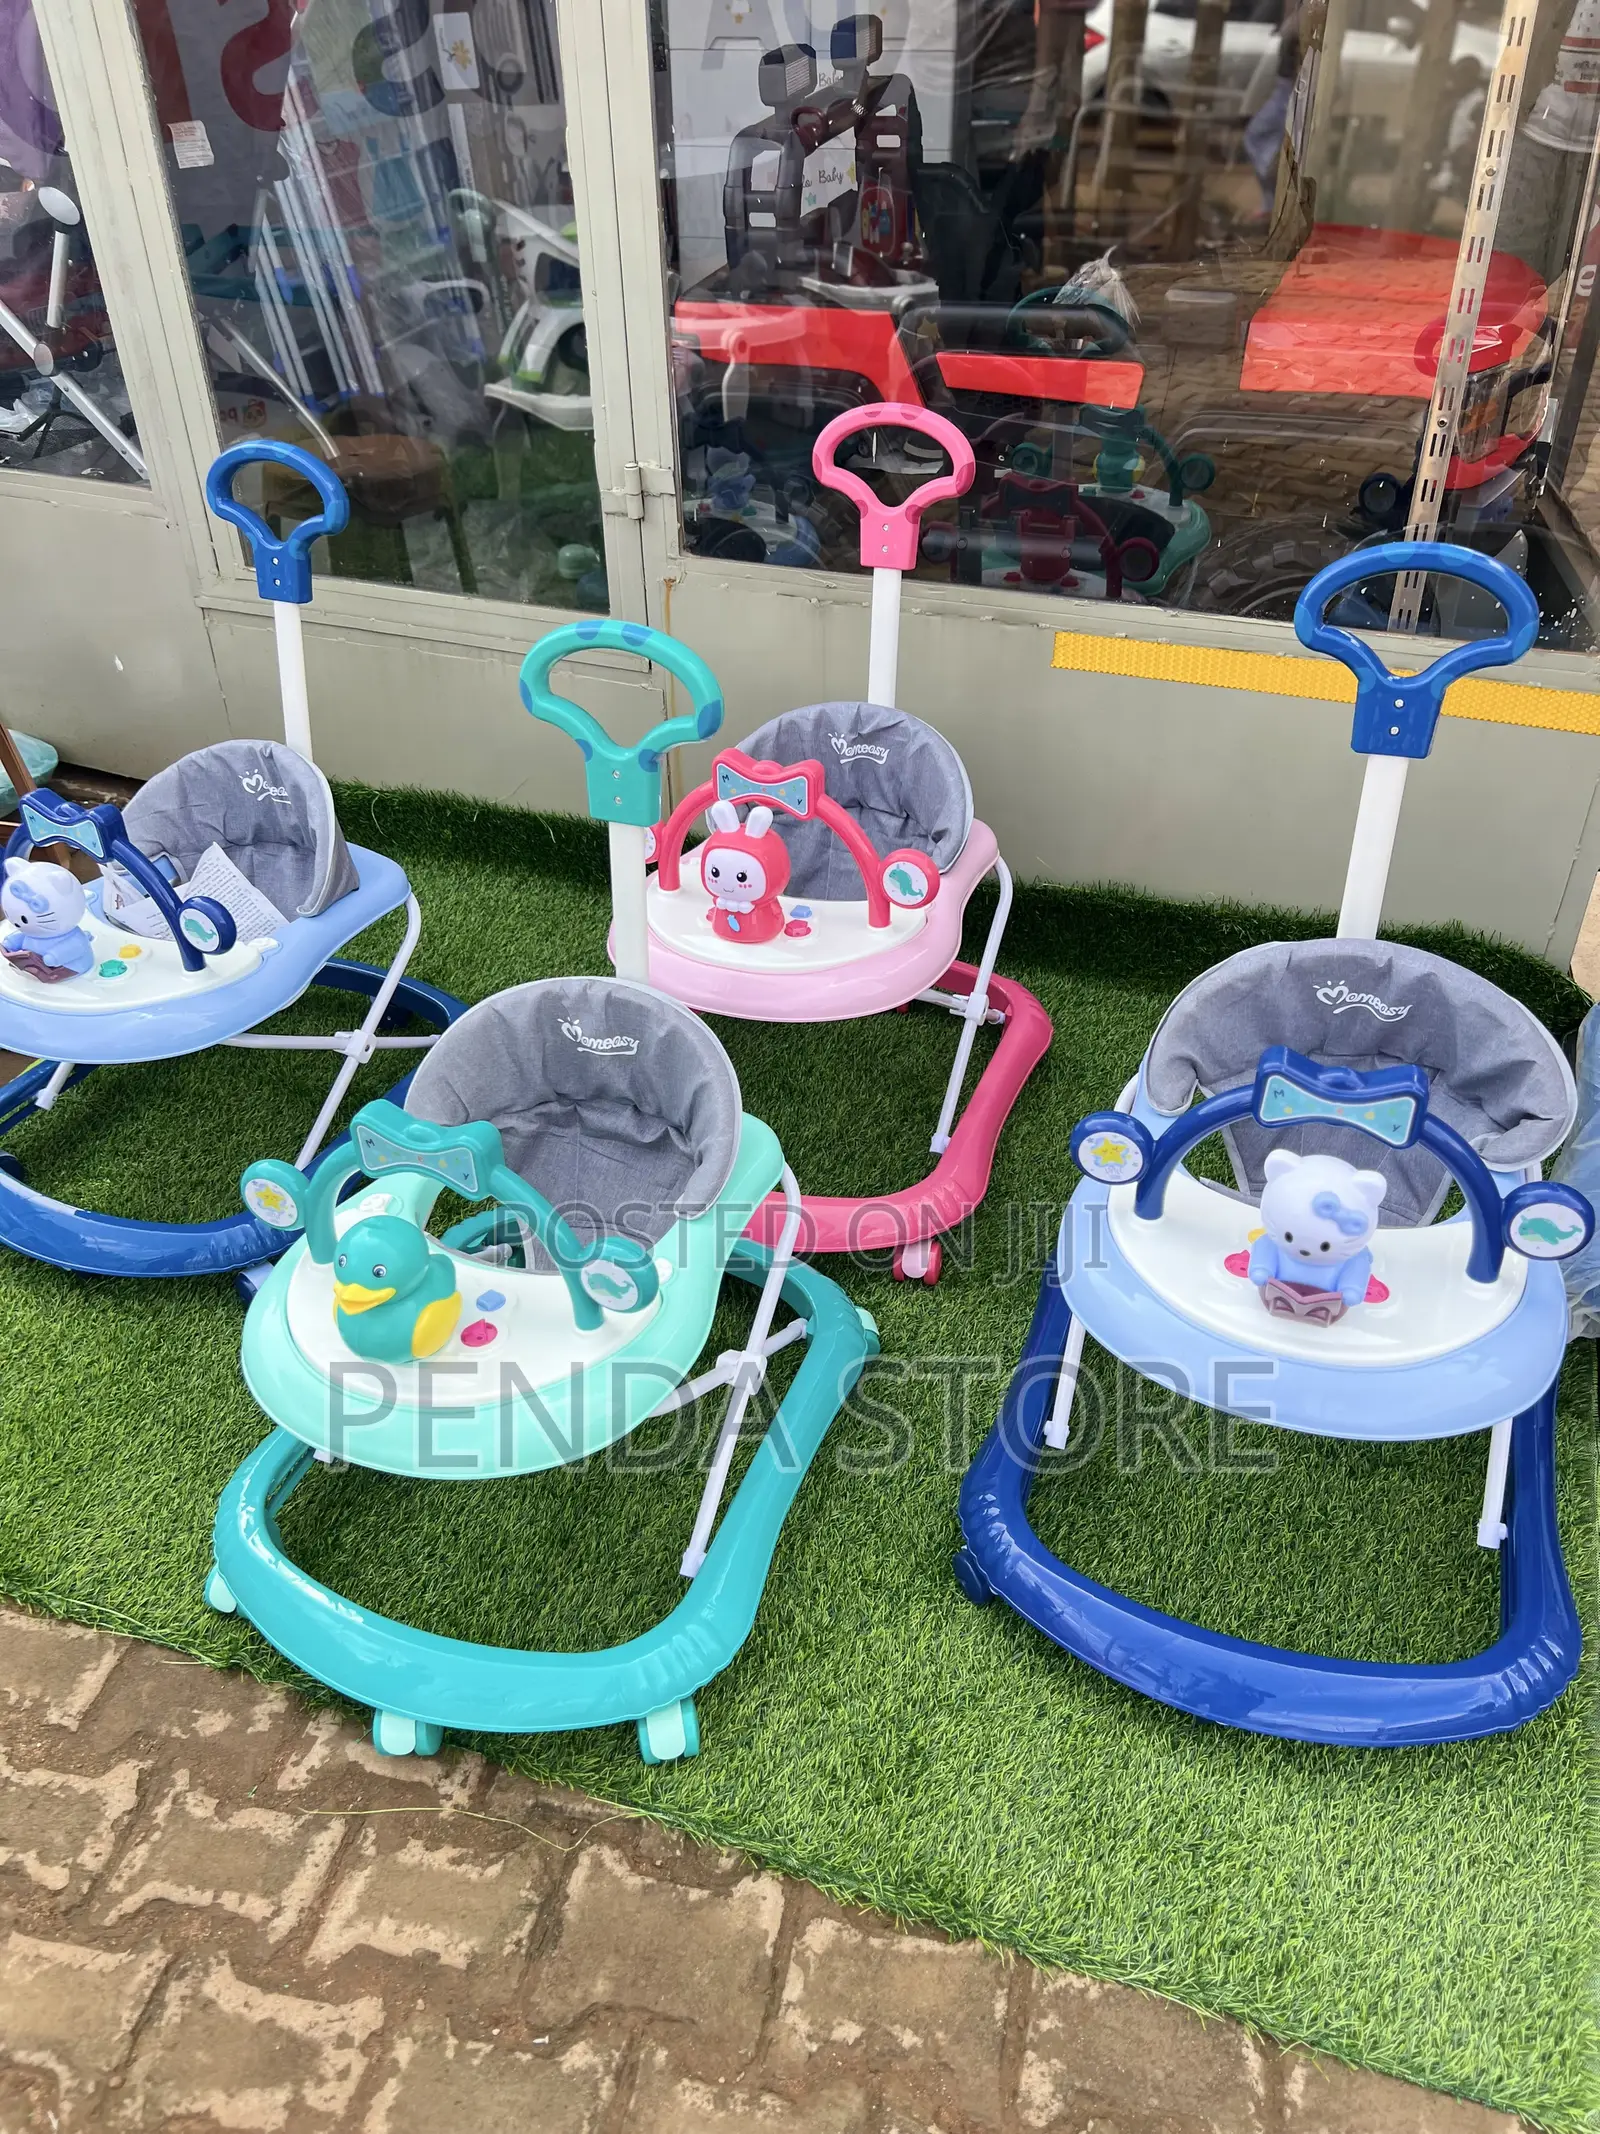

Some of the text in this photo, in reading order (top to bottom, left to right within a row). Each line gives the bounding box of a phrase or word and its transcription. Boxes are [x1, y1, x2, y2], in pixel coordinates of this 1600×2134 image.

[818, 167, 844, 185] Baby
[829, 734, 891, 765] Momeasy
[1315, 983, 1414, 1022] Momeasy
[560, 1020, 640, 1055] Momeasy
